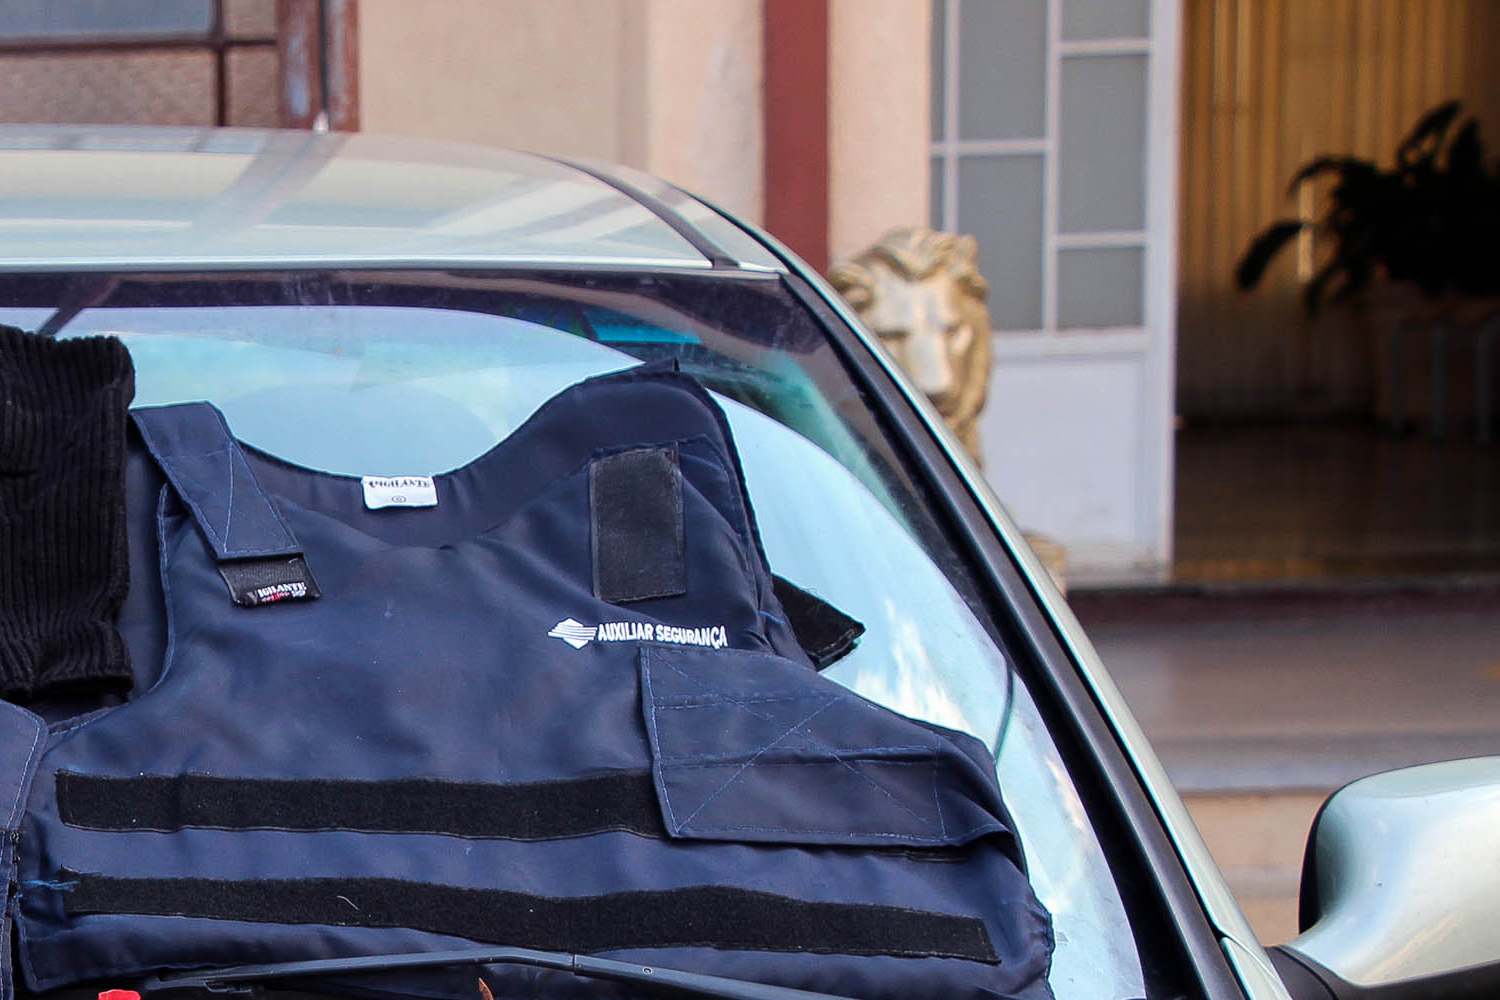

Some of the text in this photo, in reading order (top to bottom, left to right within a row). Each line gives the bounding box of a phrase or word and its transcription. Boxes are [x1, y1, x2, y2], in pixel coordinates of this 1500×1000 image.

[366, 479, 430, 488] VIGILANTE
[247, 582, 307, 604] VIGILANTE
[597, 621, 729, 650] AUXILIAR SEGURANÇA
